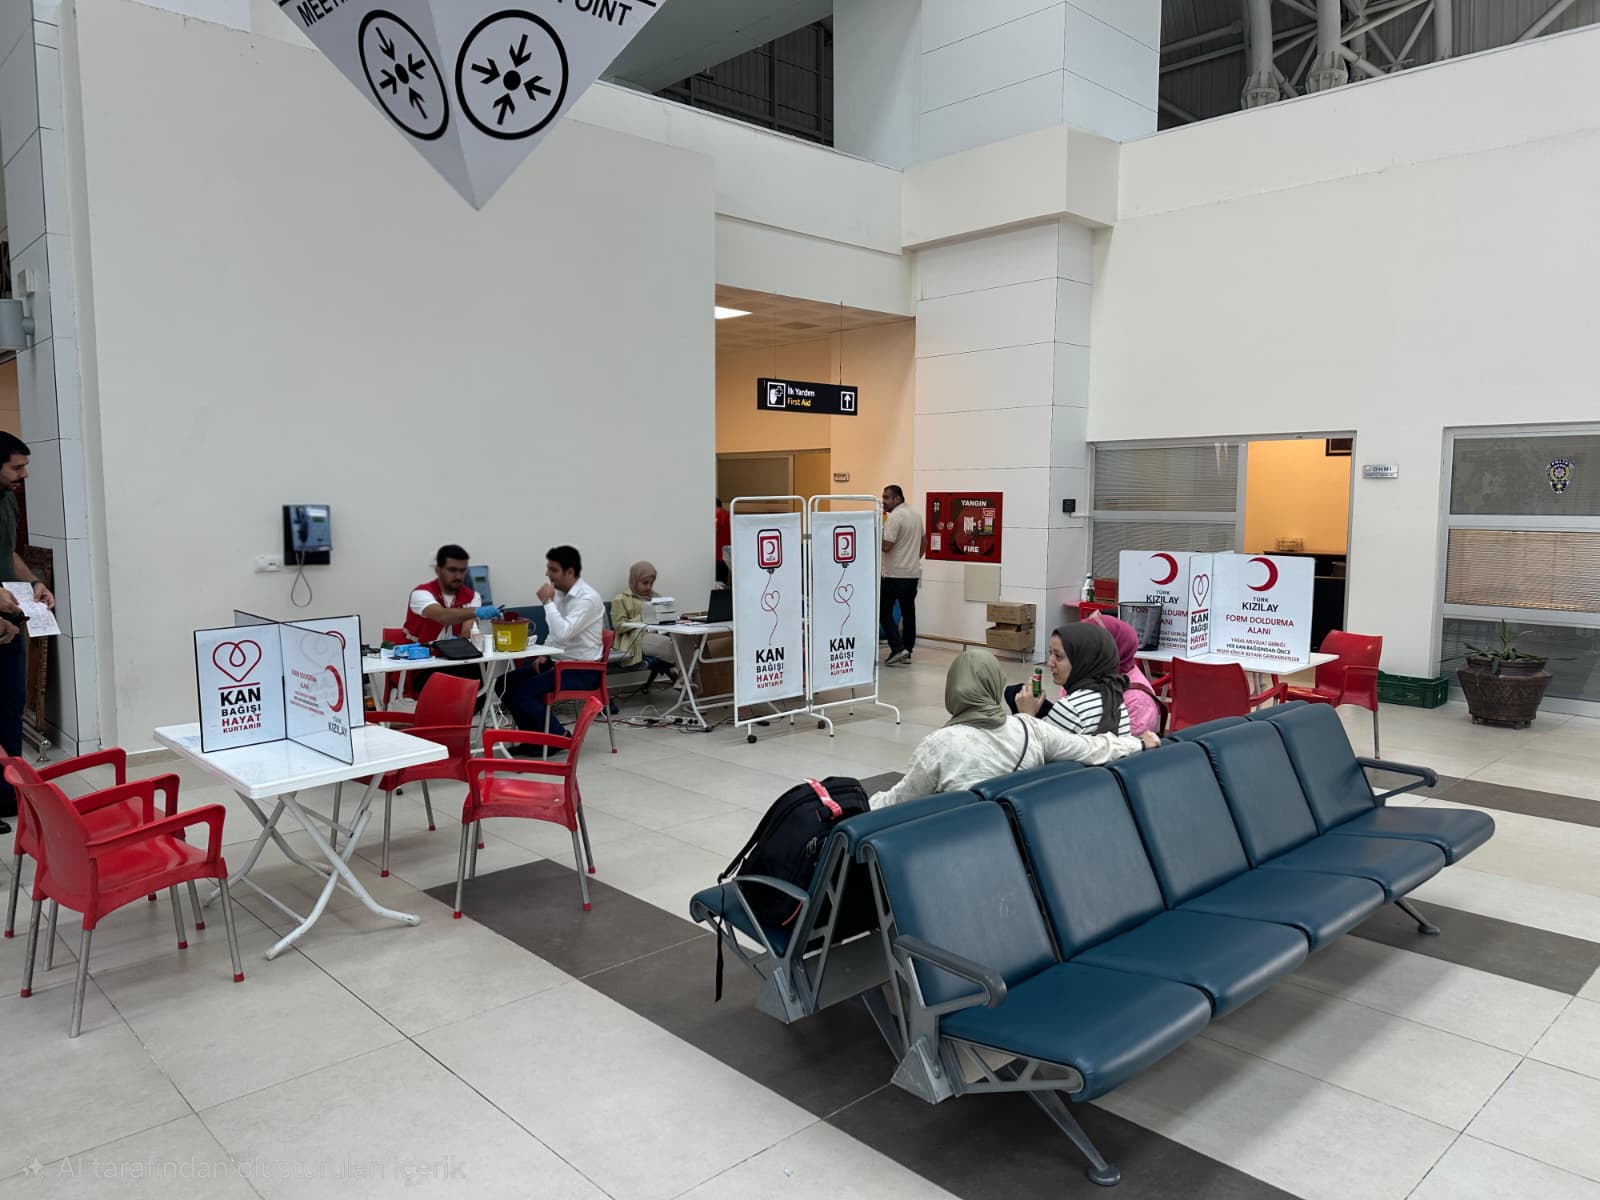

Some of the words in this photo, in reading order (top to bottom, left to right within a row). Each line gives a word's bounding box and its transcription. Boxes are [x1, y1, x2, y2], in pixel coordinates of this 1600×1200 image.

[557, 0, 633, 26] OINT
[801, 398, 811, 407] Aid
[963, 545, 980, 553] FIRE
[1146, 594, 1179, 604] KIZILAY
[1242, 602, 1279, 612] KIZILAY
[1190, 613, 1209, 625] KAN
[1226, 614, 1248, 623] FORM
[1249, 616, 1294, 627] DOLDURMA
[1247, 627, 1271, 635] ALANI
[1190, 633, 1208, 644] HAYAT
[829, 637, 855, 653] KAN
[755, 647, 785, 664] KAN
[830, 651, 854, 662] BAĞIŞI
[756, 662, 784, 674] BAĞIŞI
[830, 660, 854, 670] HAYAT
[756, 672, 783, 682] HAYAT
[220, 687, 262, 706] KAN
[221, 703, 261, 717] BAĞIŞI
[222, 713, 262, 727] HAYAT
[223, 722, 262, 734] KURTARIR
